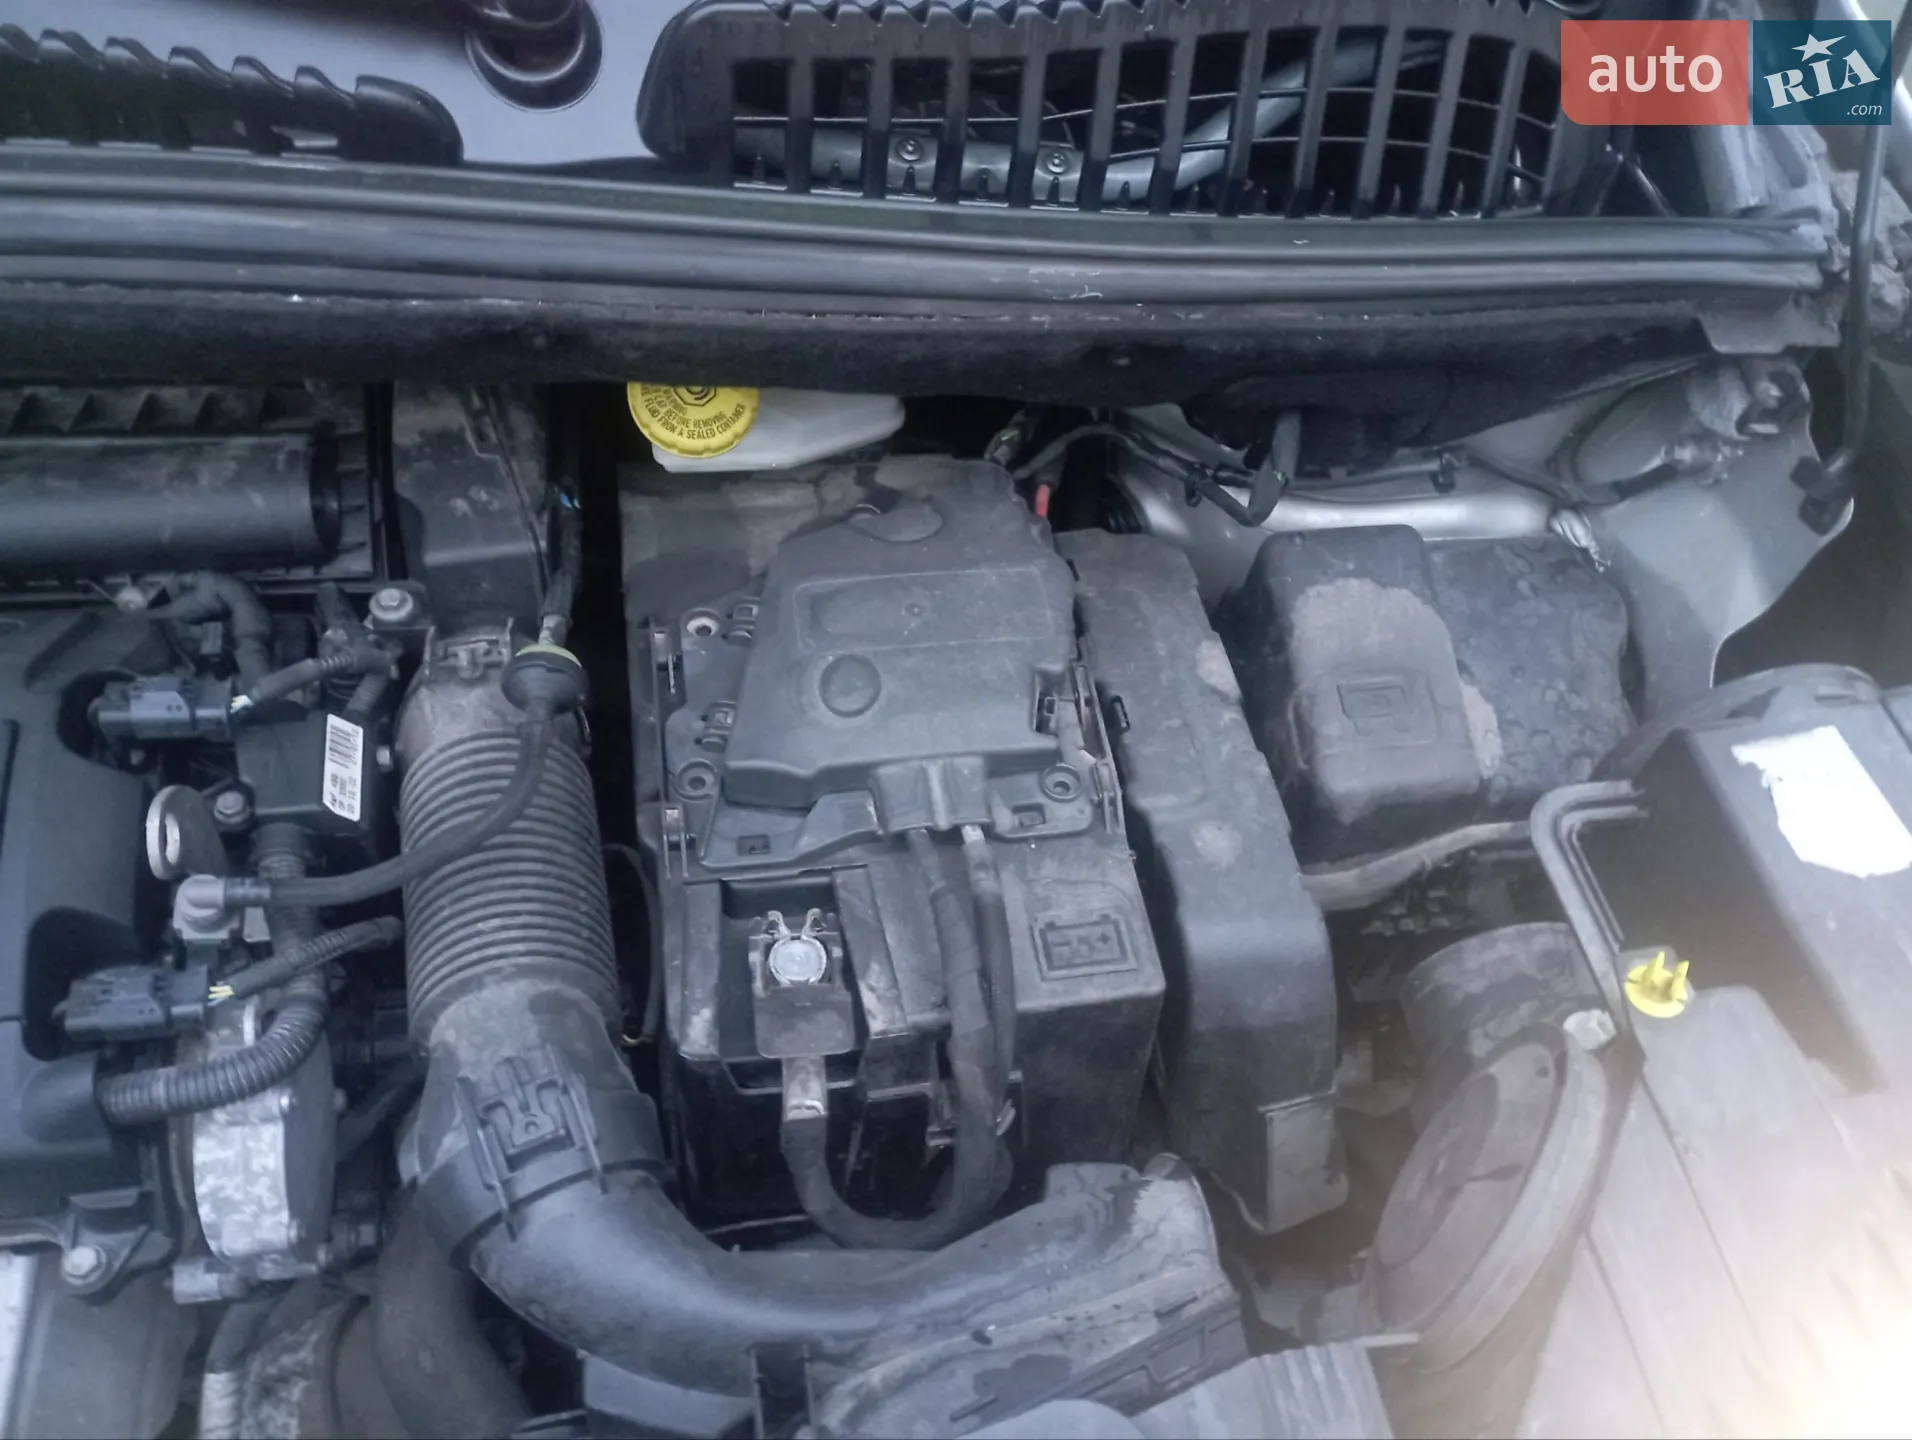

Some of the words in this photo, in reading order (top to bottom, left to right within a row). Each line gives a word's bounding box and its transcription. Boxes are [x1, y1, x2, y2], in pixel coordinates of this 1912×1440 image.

[644, 398, 661, 419] FLUID
[657, 416, 677, 434] FROM
[677, 428, 684, 437] A
[686, 427, 716, 440] SEALED
[716, 403, 746, 434] CONTAINER
[664, 408, 691, 429] BEFORE
[693, 411, 728, 430] REMOVING
